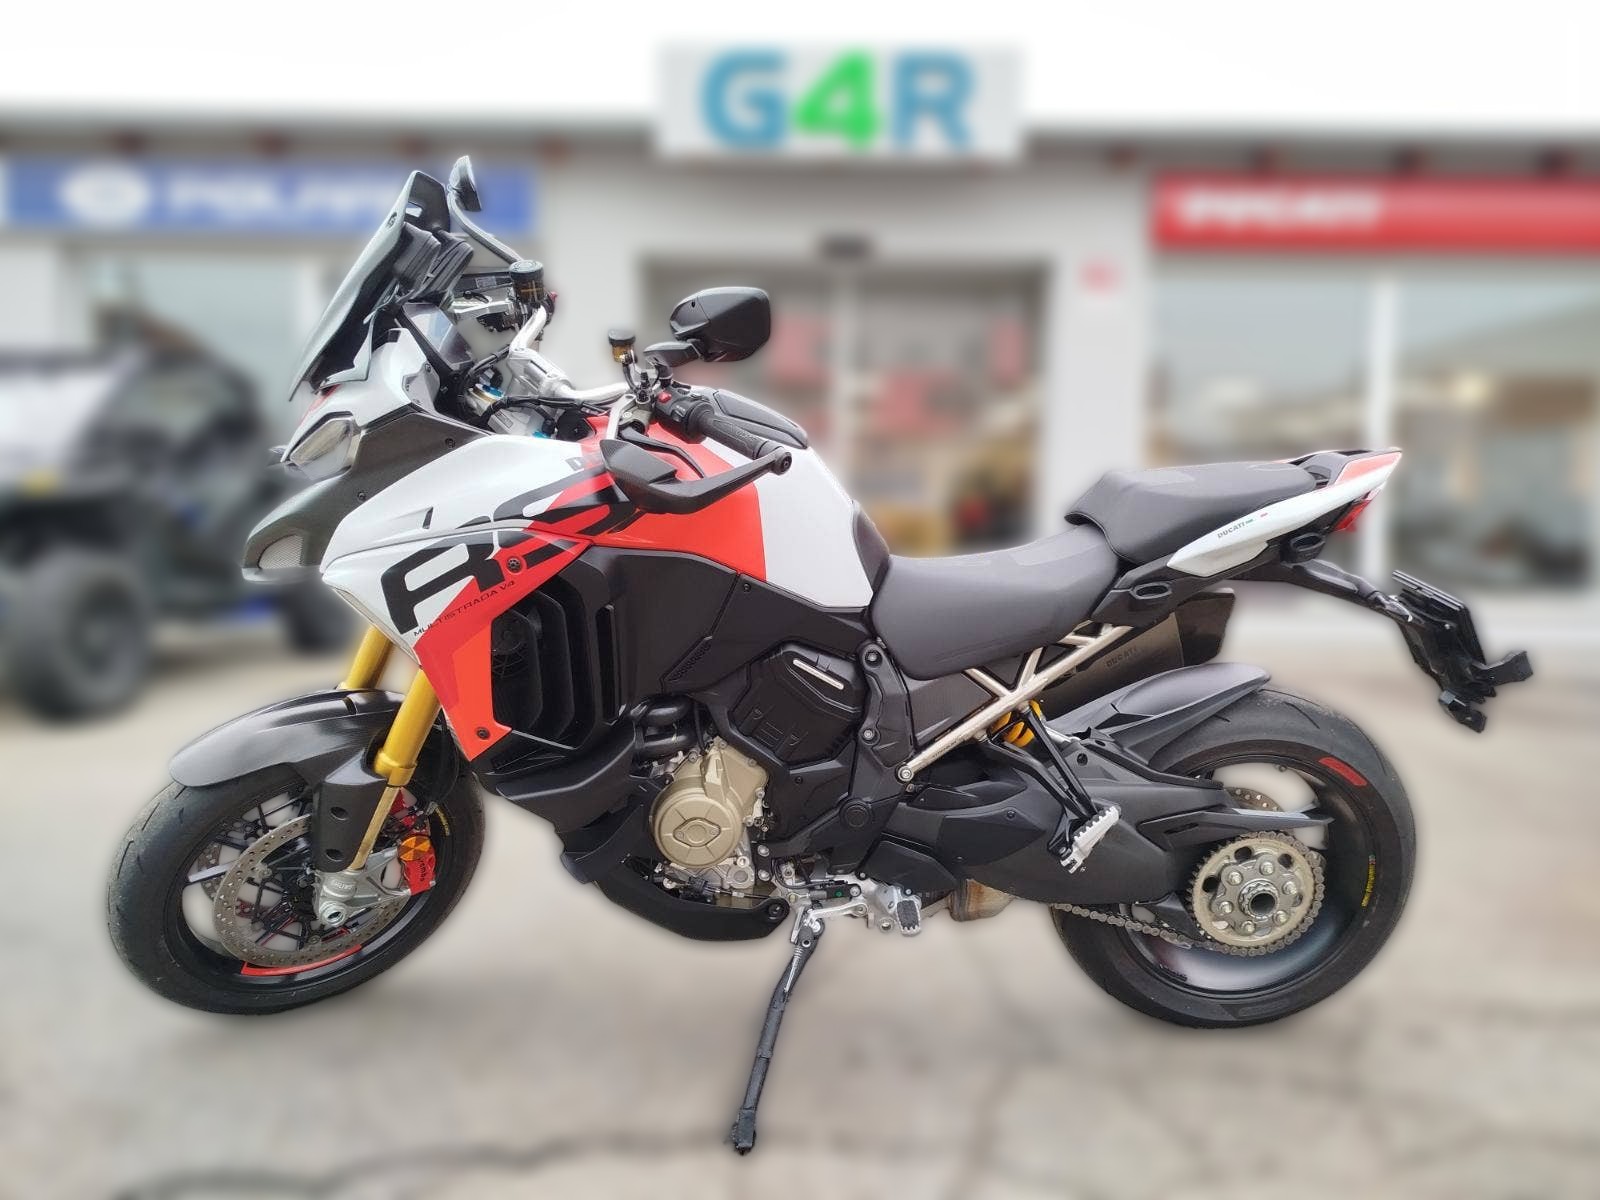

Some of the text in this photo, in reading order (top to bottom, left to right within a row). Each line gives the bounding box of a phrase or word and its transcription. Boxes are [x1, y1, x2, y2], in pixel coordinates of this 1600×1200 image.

[698, 47, 974, 154] G4R
[1217, 520, 1246, 539] DUCATI
[413, 579, 516, 637] MULTISTRADA V4
